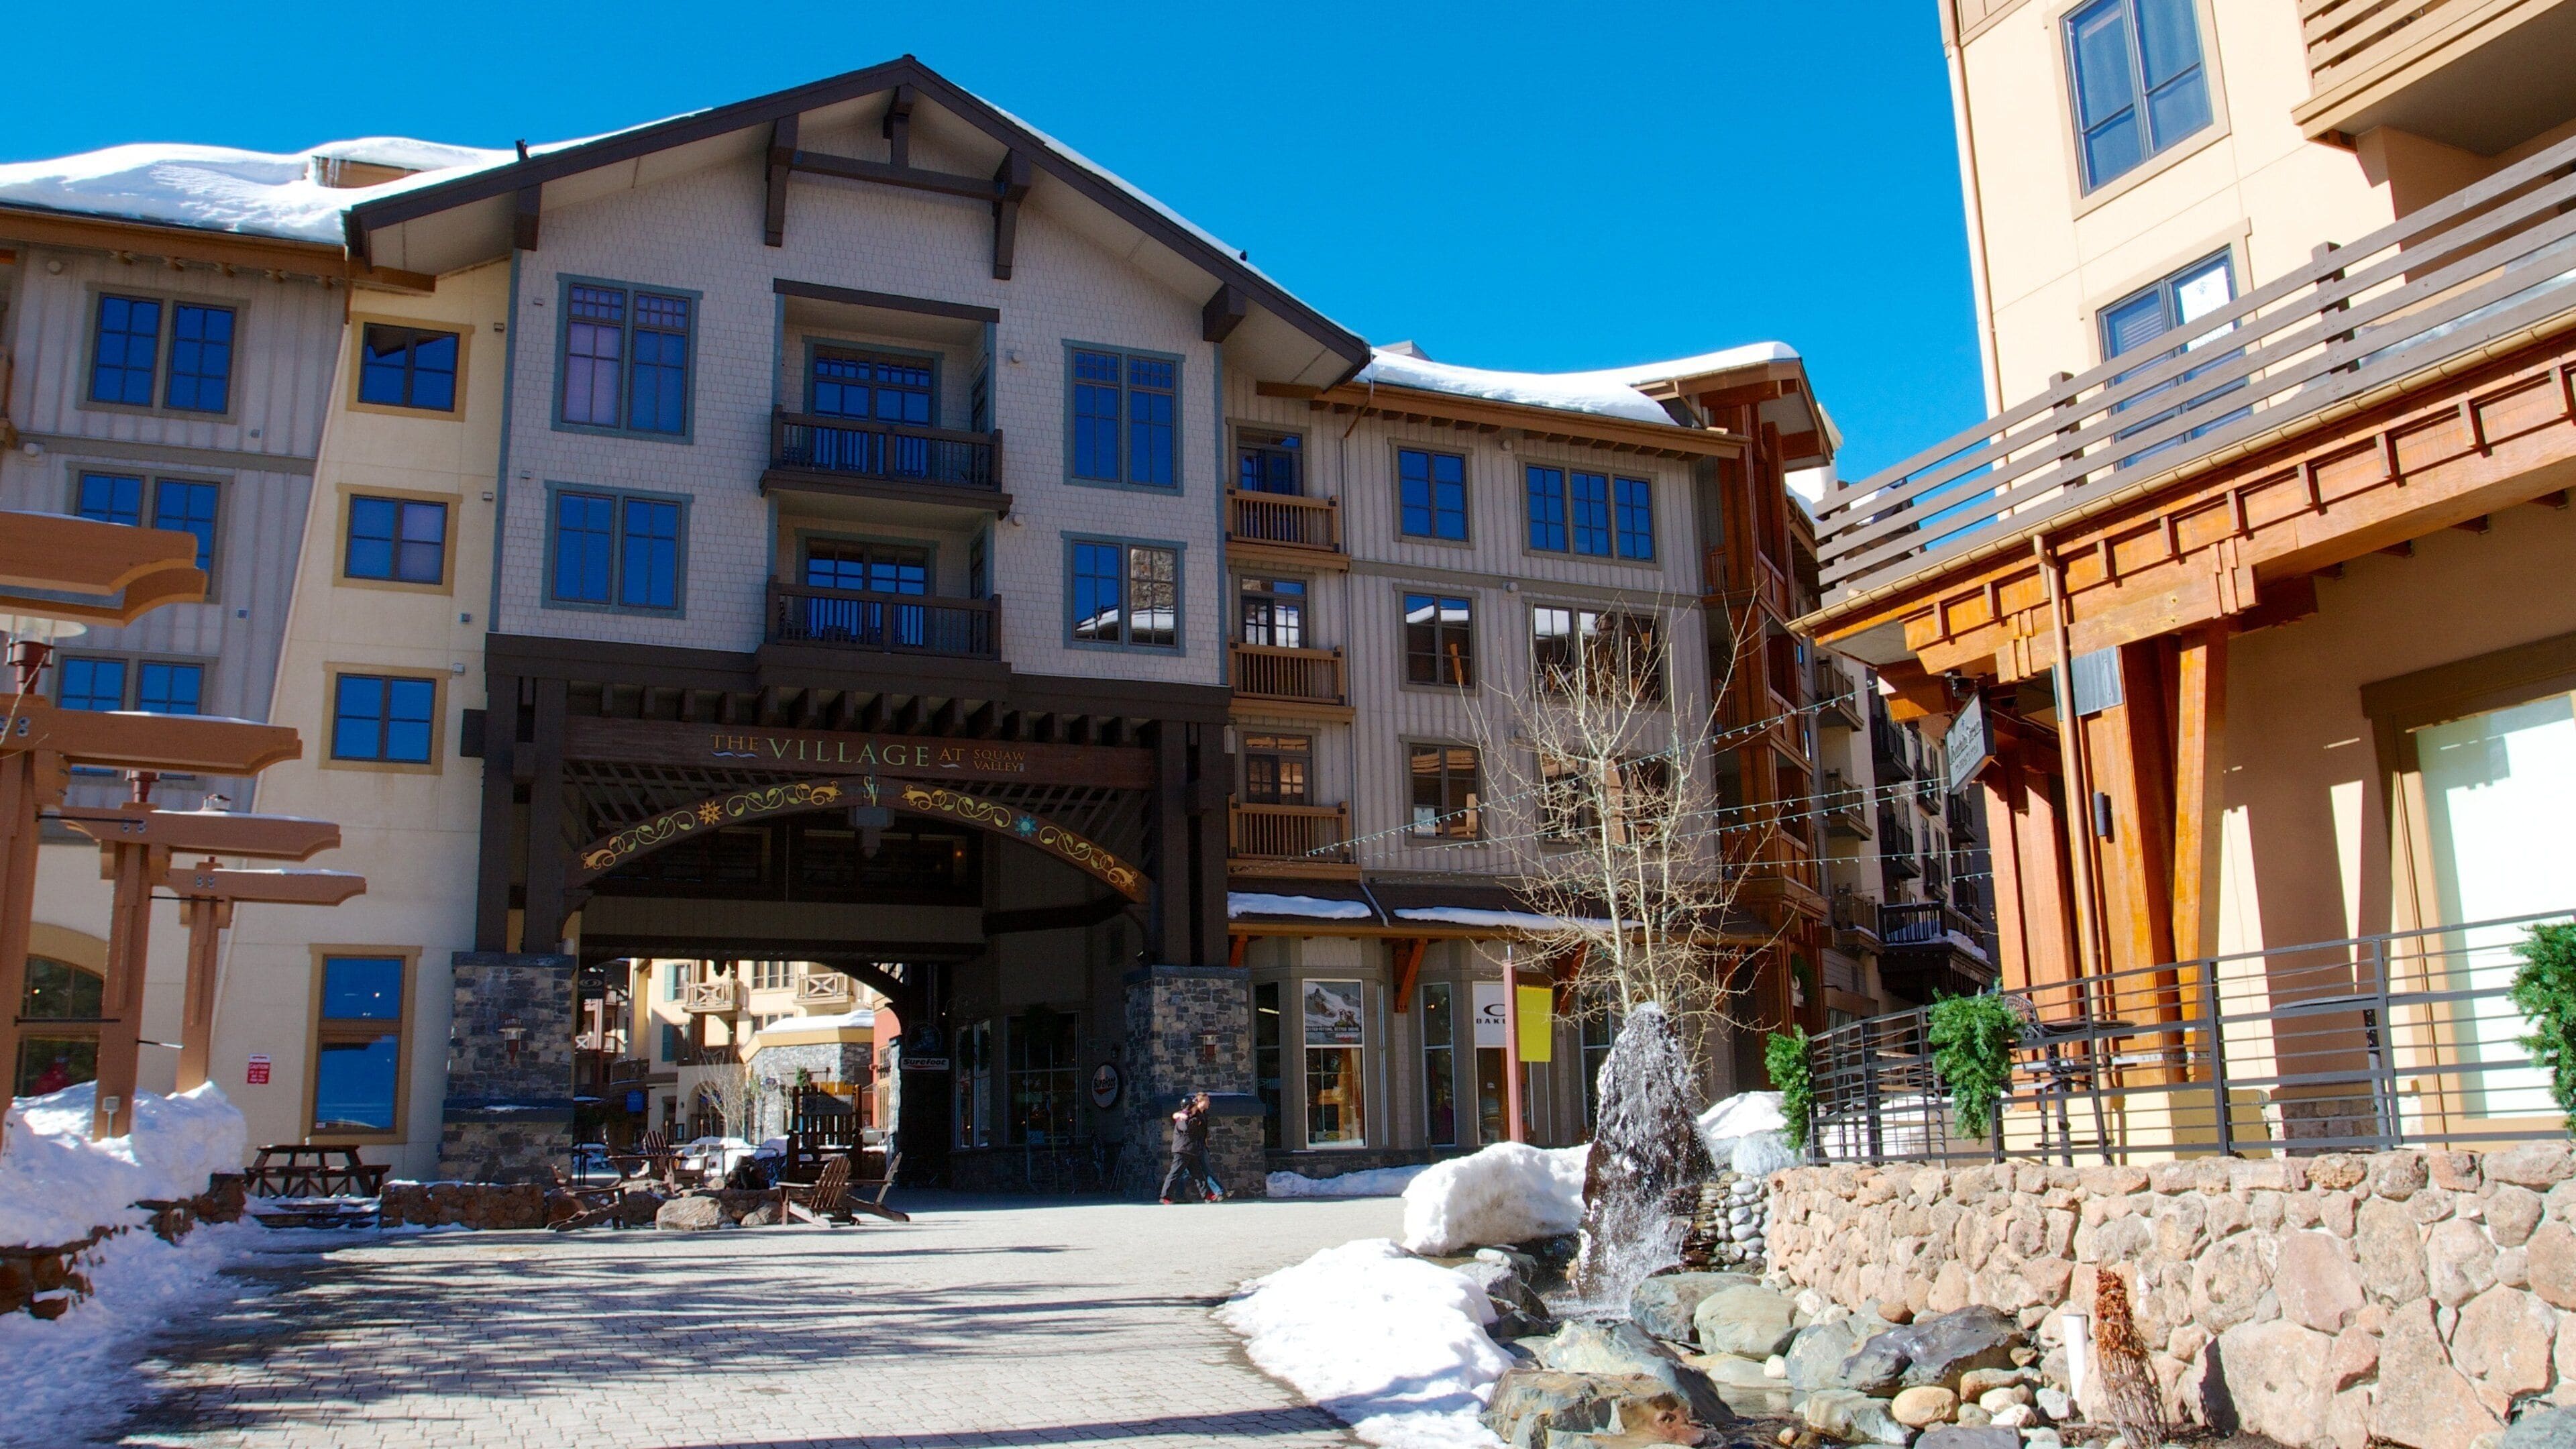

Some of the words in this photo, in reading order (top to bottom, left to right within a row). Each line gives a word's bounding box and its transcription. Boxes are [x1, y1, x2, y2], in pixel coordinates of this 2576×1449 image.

[710, 735, 759, 751] THE
[767, 738, 929, 767] VILLAGE
[938, 747, 965, 761] AT
[973, 749, 1025, 762] SQUAW
[973, 761, 1020, 772] VALLEY
